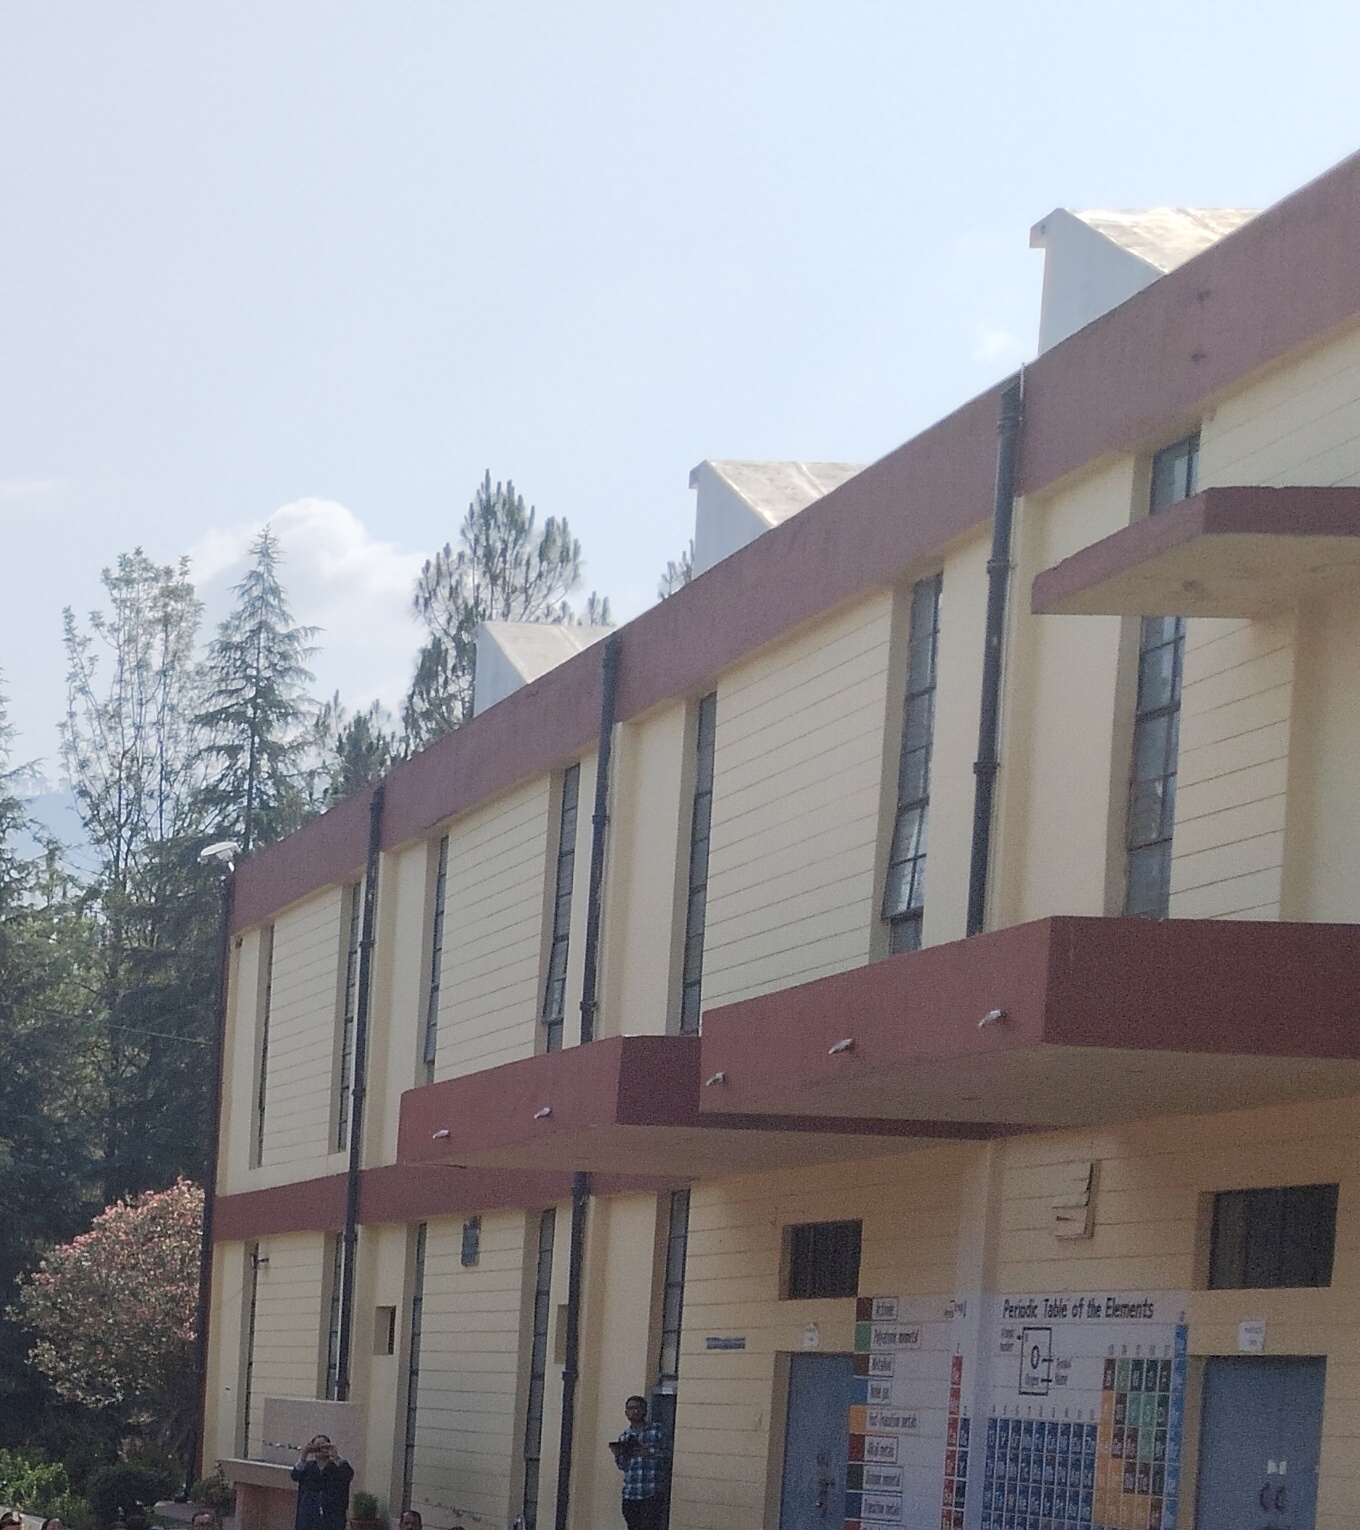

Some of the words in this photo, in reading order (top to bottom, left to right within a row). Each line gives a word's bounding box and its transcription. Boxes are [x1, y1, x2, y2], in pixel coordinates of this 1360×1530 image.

[1002, 1299, 1038, 1319] Periodic
[1043, 1298, 1068, 1319] Table
[1072, 1297, 1085, 1319] of
[1086, 1298, 1101, 1318] the
[1104, 1296, 1154, 1320] Elements
